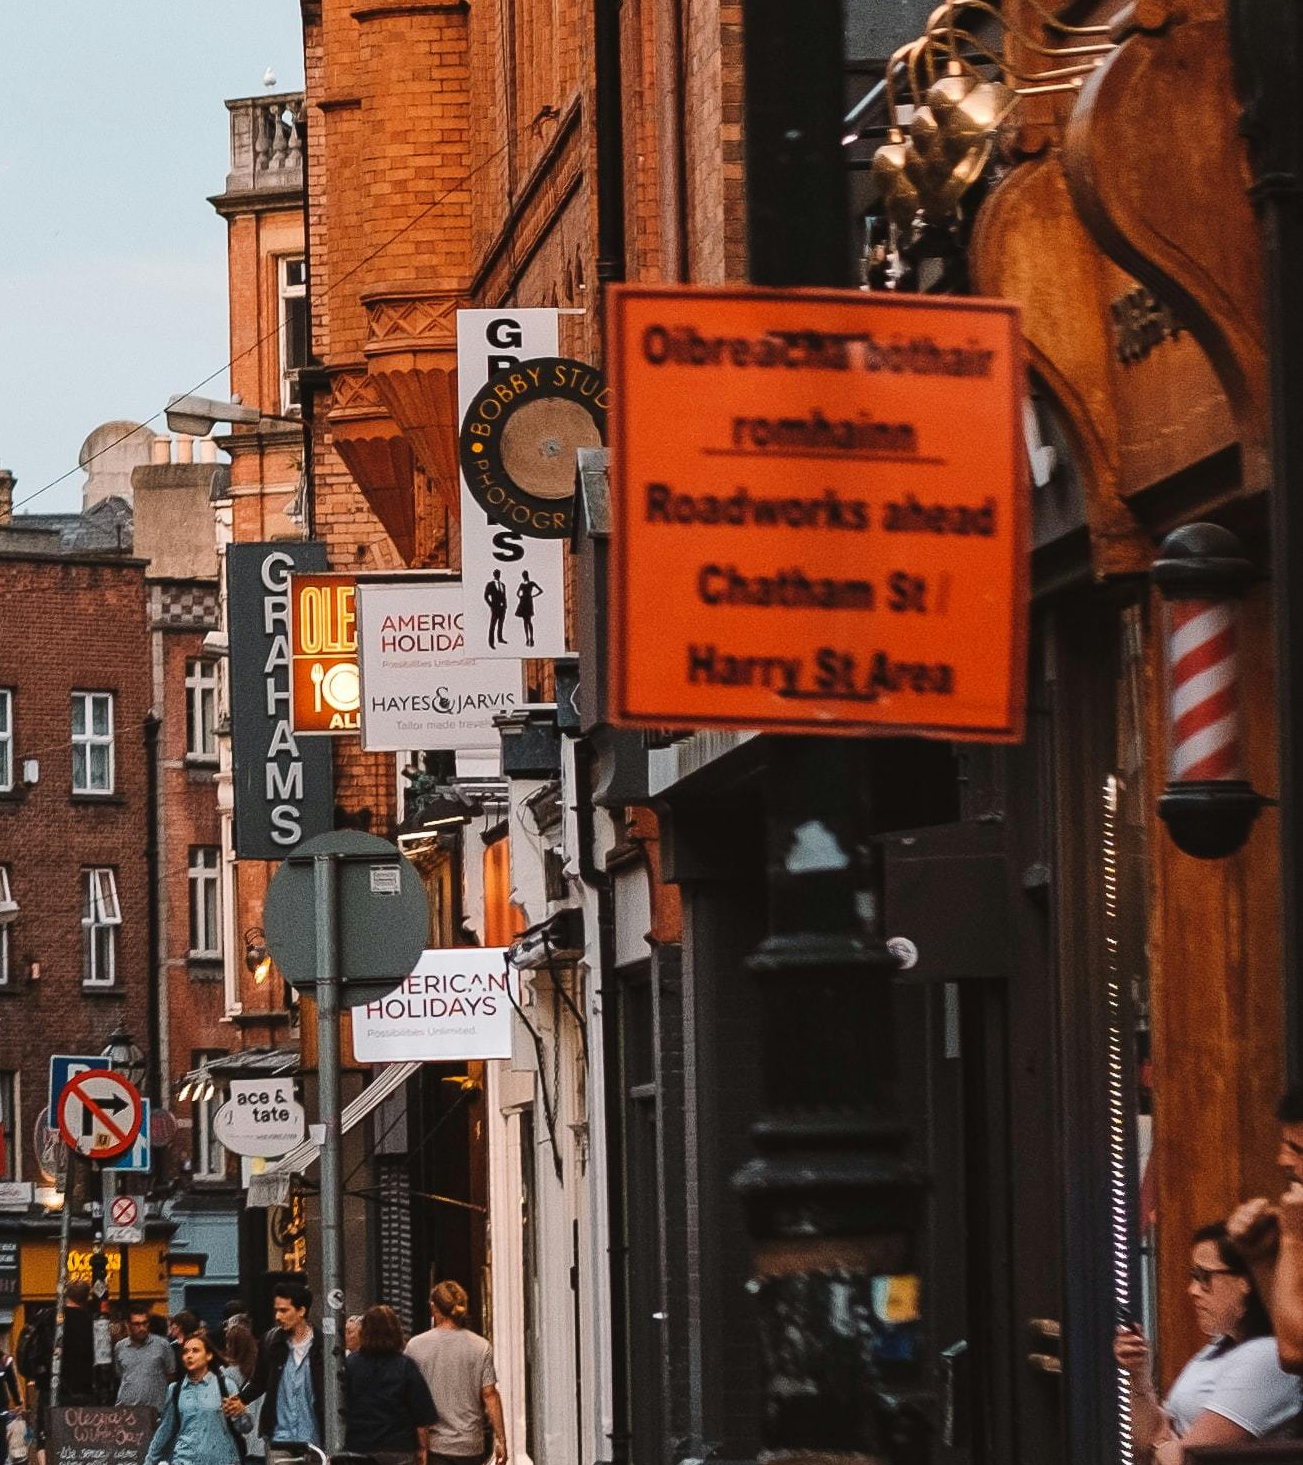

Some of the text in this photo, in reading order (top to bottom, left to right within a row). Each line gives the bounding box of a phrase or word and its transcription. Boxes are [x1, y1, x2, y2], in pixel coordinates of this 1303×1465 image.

[471, 366, 540, 437] BOBBY
[646, 482, 995, 536] Roadworks ahead
[698, 563, 876, 611] Chatham
[889, 571, 927, 614] St
[300, 586, 358, 656] OLE
[686, 644, 955, 694] Harry St Area
[260, 551, 304, 846] GRAHAMS
[397, 721, 423, 731] Tailor
[427, 720, 456, 730] made
[367, 996, 497, 1020] HOLIDAYS
[237, 1089, 287, 1106] ace &
[253, 1107, 290, 1123] tate
